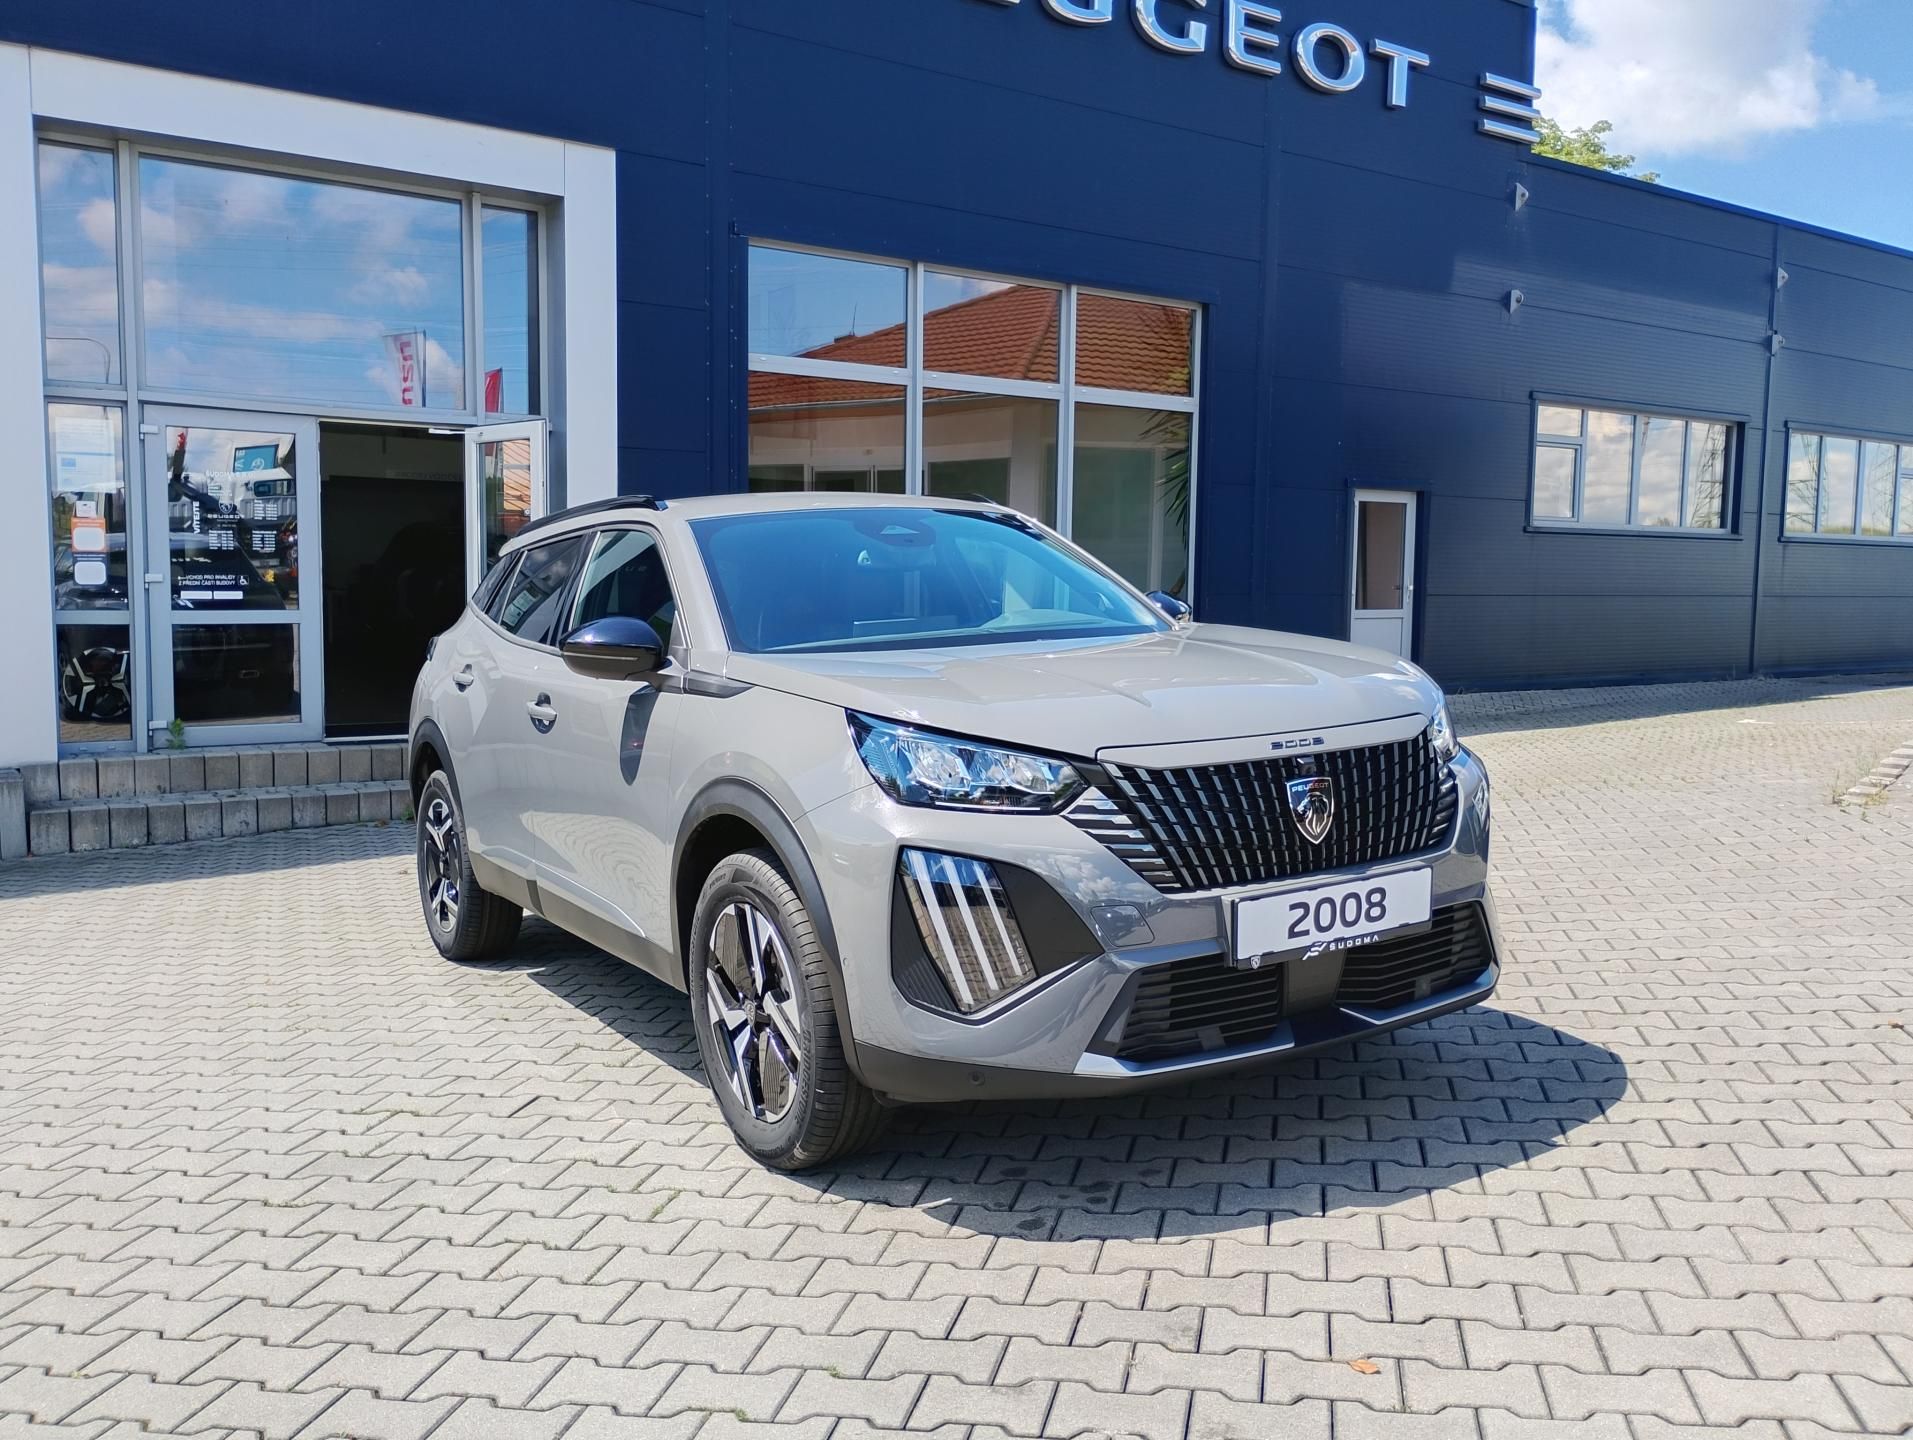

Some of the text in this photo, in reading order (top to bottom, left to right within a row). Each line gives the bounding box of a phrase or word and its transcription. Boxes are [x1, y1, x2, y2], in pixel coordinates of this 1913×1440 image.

[998, 0, 1430, 108] GEOT
[1291, 782, 1329, 793] PEUGEOT
[1287, 887, 1387, 940] 2008
[1329, 934, 1379, 951] SUDOMA
